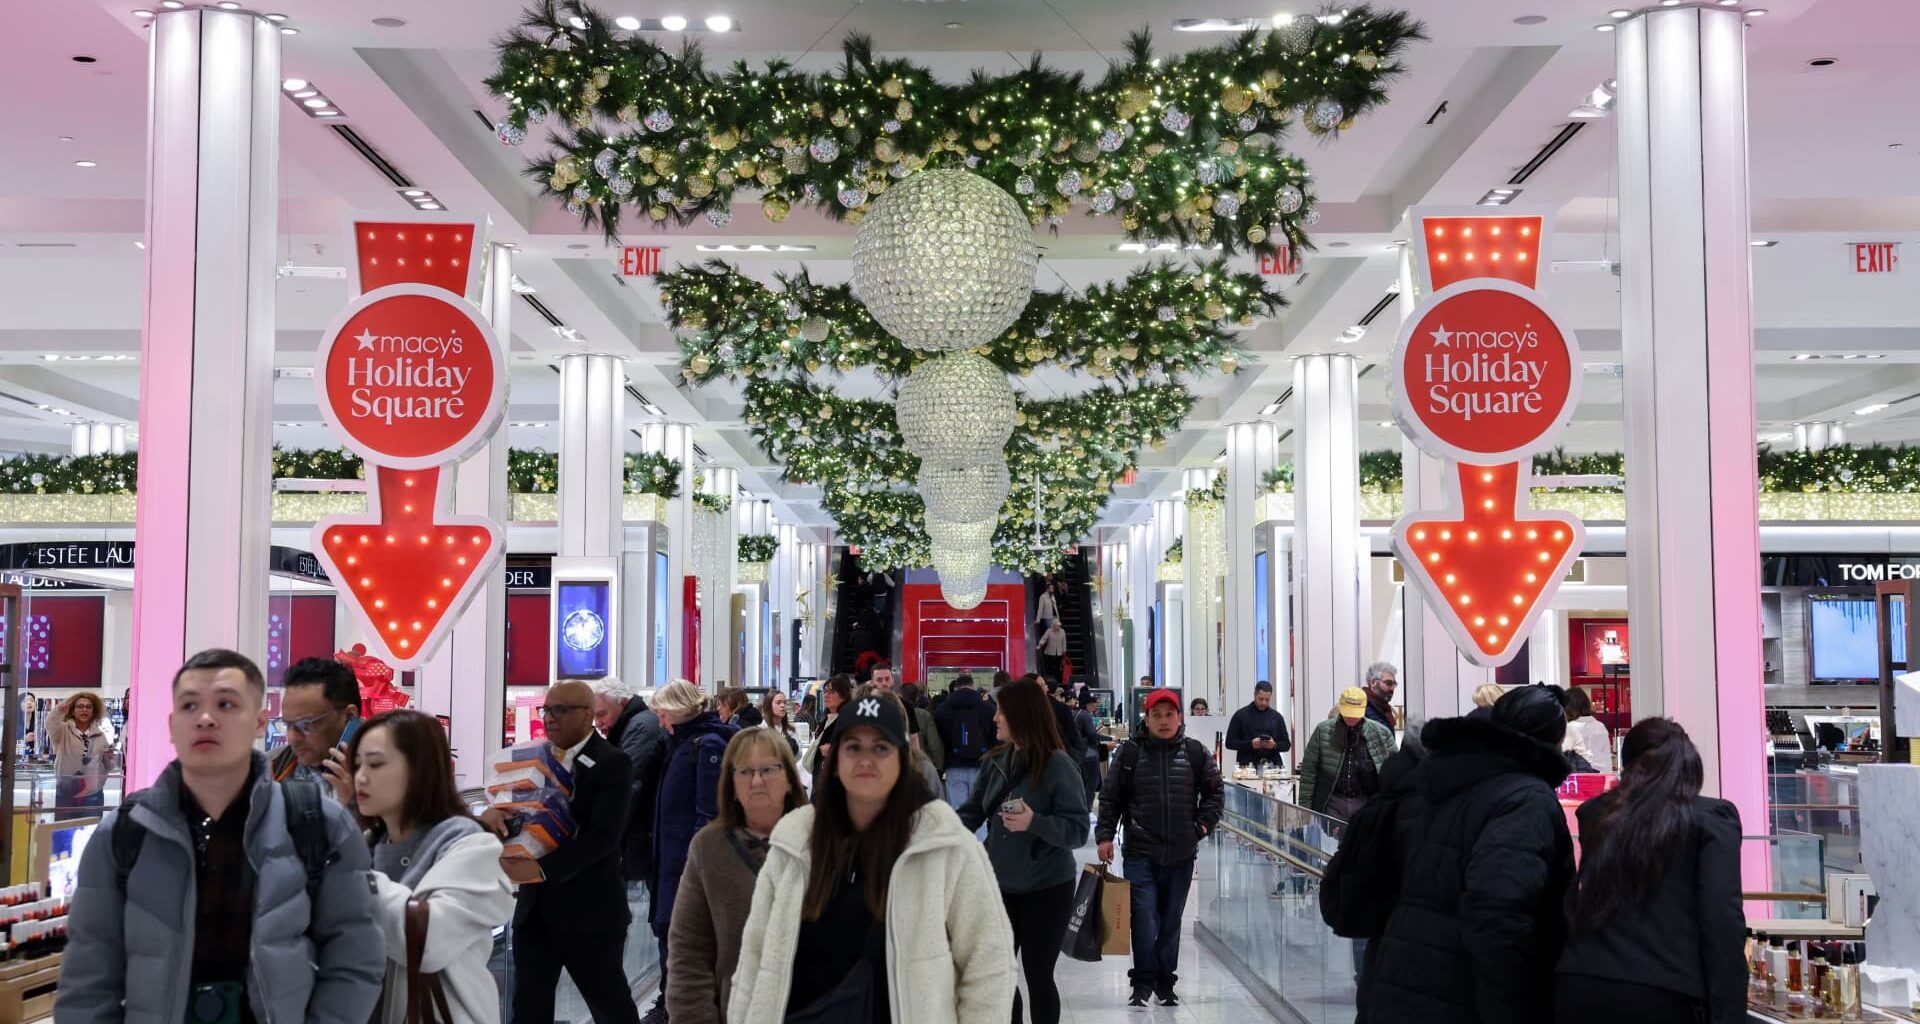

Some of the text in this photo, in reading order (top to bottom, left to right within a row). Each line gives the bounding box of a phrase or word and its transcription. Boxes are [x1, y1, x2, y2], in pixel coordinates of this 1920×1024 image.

[624, 247, 661, 276] EXIT
[1856, 243, 1894, 273] EXIT
[380, 329, 463, 359] macy's
[1456, 323, 1538, 353] macy's
[347, 357, 472, 395] Holiday
[1424, 352, 1548, 389] Holiday
[351, 388, 464, 425] Square
[1430, 384, 1542, 421] Square
[95, 547, 136, 564] LAU
[1838, 564, 1920, 581] TOM FO
[856, 698, 880, 718] NY
